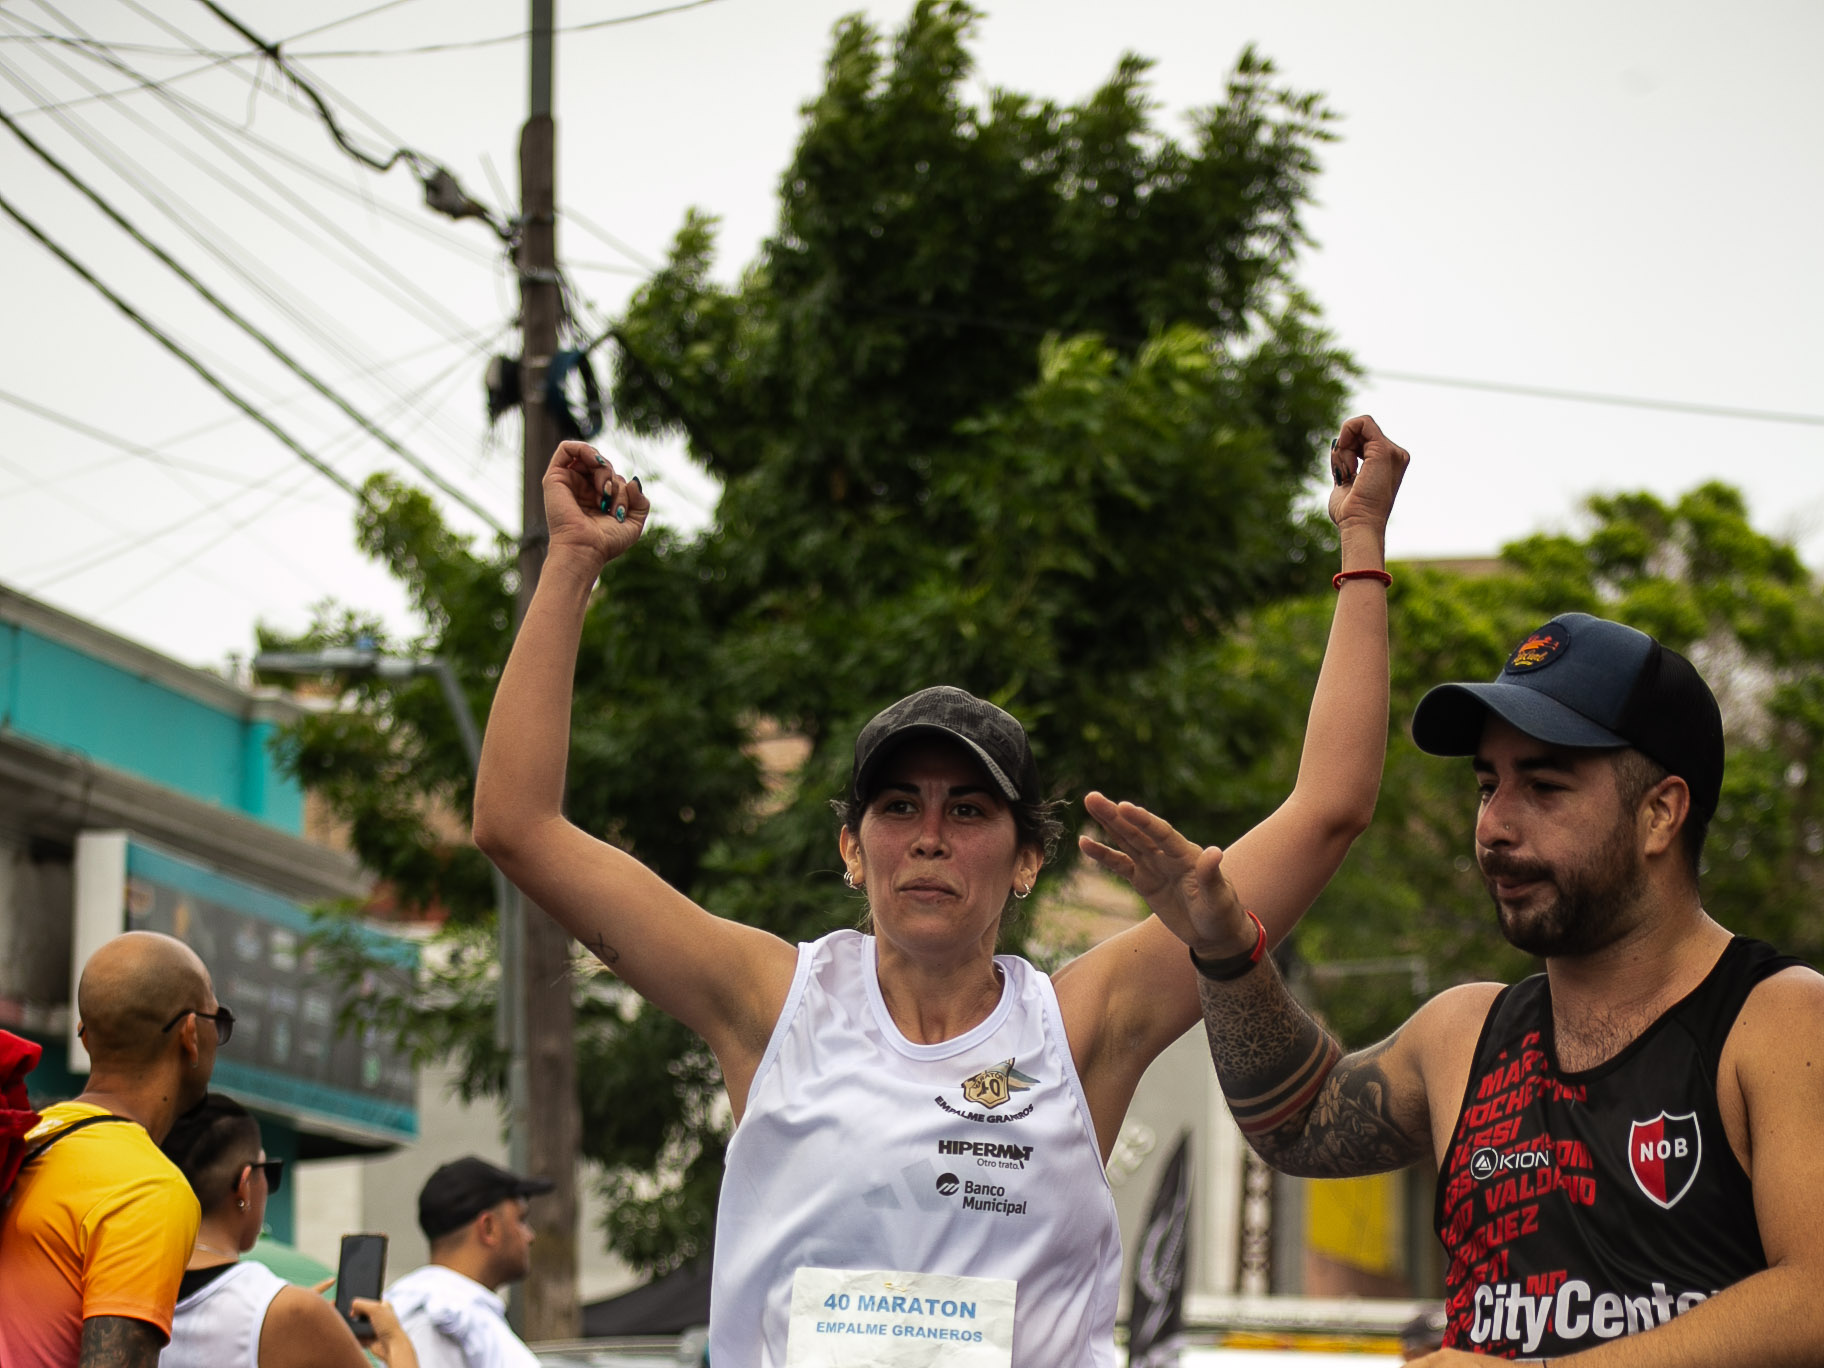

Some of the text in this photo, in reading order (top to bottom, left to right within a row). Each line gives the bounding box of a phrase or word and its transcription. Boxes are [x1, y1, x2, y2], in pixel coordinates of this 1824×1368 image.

[934, 1095, 1034, 1124] EMPALME GRANEROS
[1499, 1149, 1549, 1170] KION
[1640, 1137, 1688, 1163] NOB
[976, 1158, 997, 1168] Otro
[964, 1180, 1005, 1197] Banco
[962, 1195, 1028, 1217] Municipal
[823, 1293, 977, 1319] 40 MARATON
[1470, 1279, 1719, 1354] CityCent
[816, 1321, 983, 1343] EMPALME GRANEROS
